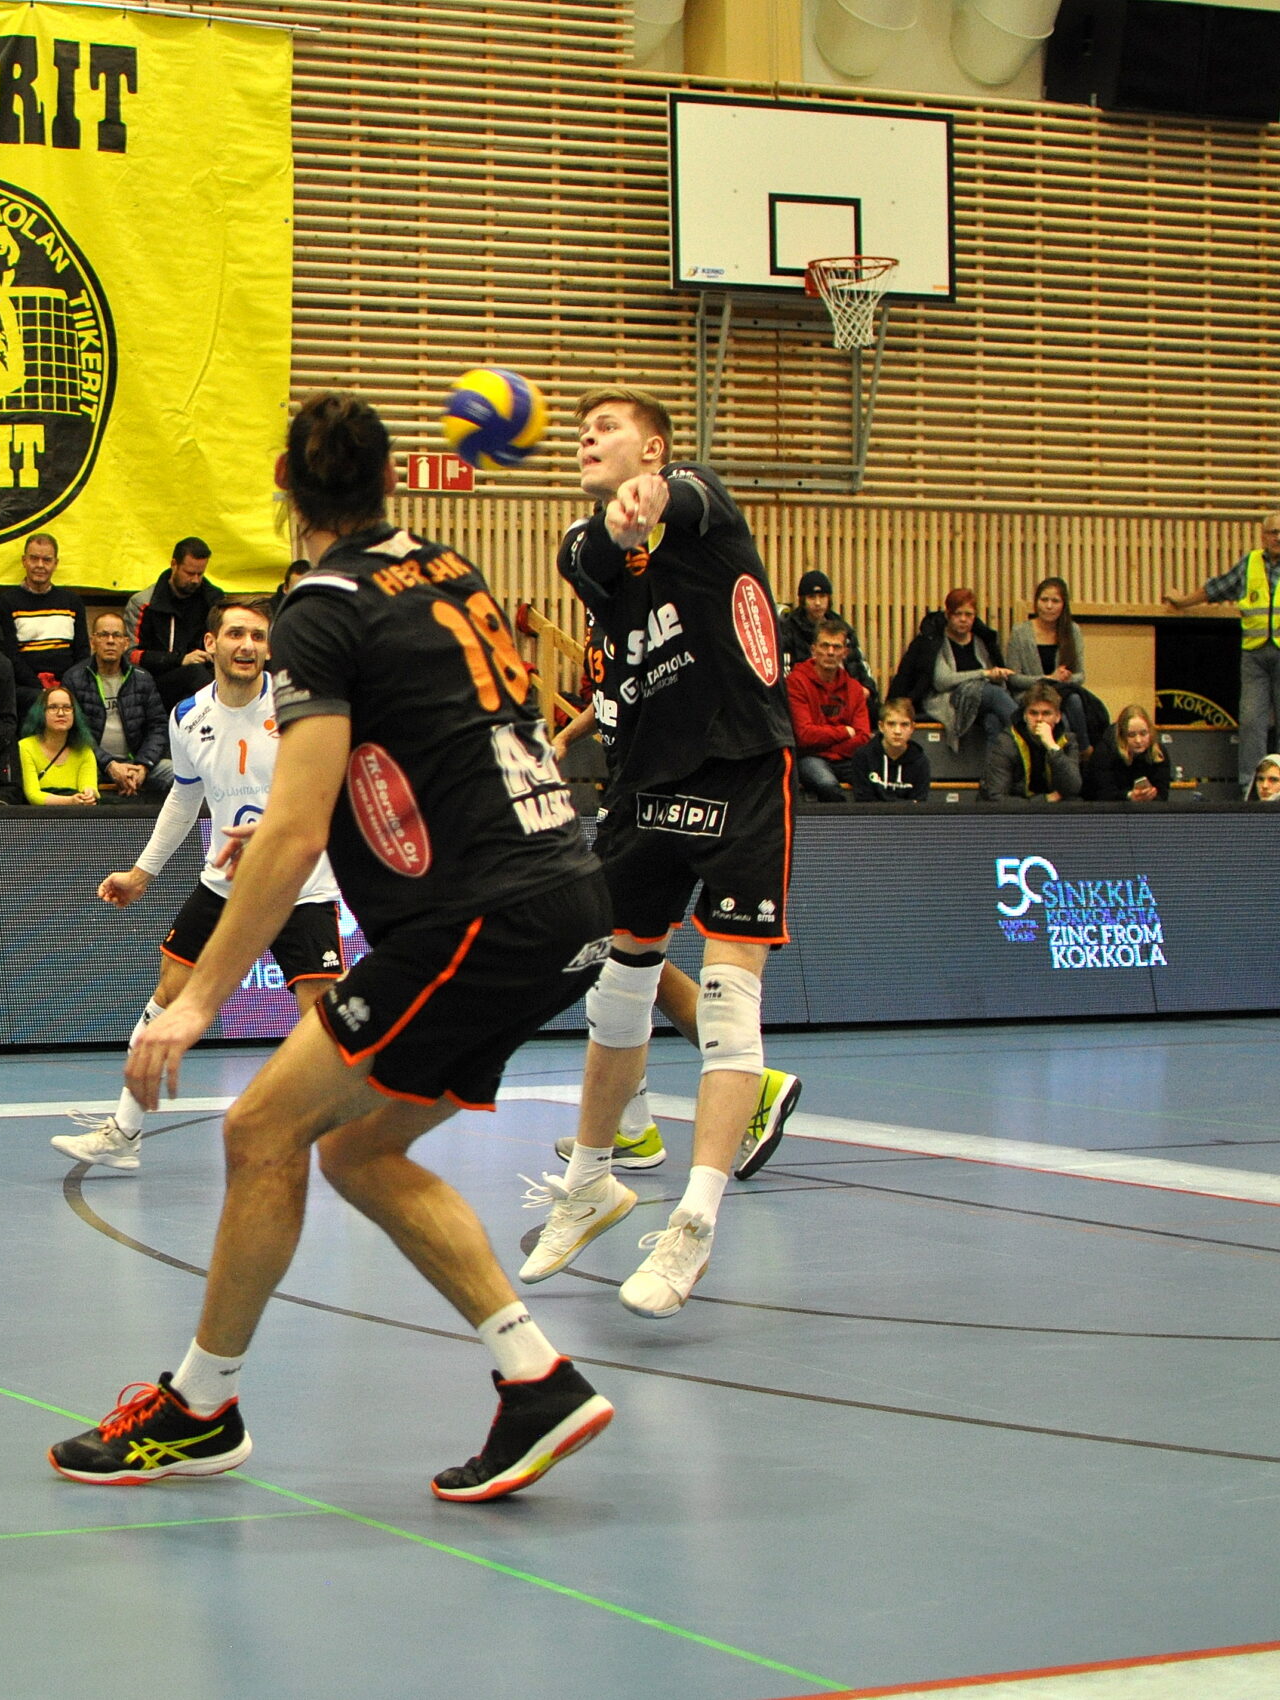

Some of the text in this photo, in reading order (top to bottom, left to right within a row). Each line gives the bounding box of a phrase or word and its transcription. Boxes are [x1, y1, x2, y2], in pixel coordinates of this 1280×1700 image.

[69, 289, 100, 423] TIIKERIT
[238, 739, 248, 775] 1
[995, 855, 1059, 917] 50
[1041, 873, 1158, 909] SINKKIÄ
[1048, 922, 1165, 946] ZINC FROM
[1052, 943, 1168, 968] KOKKOLA
